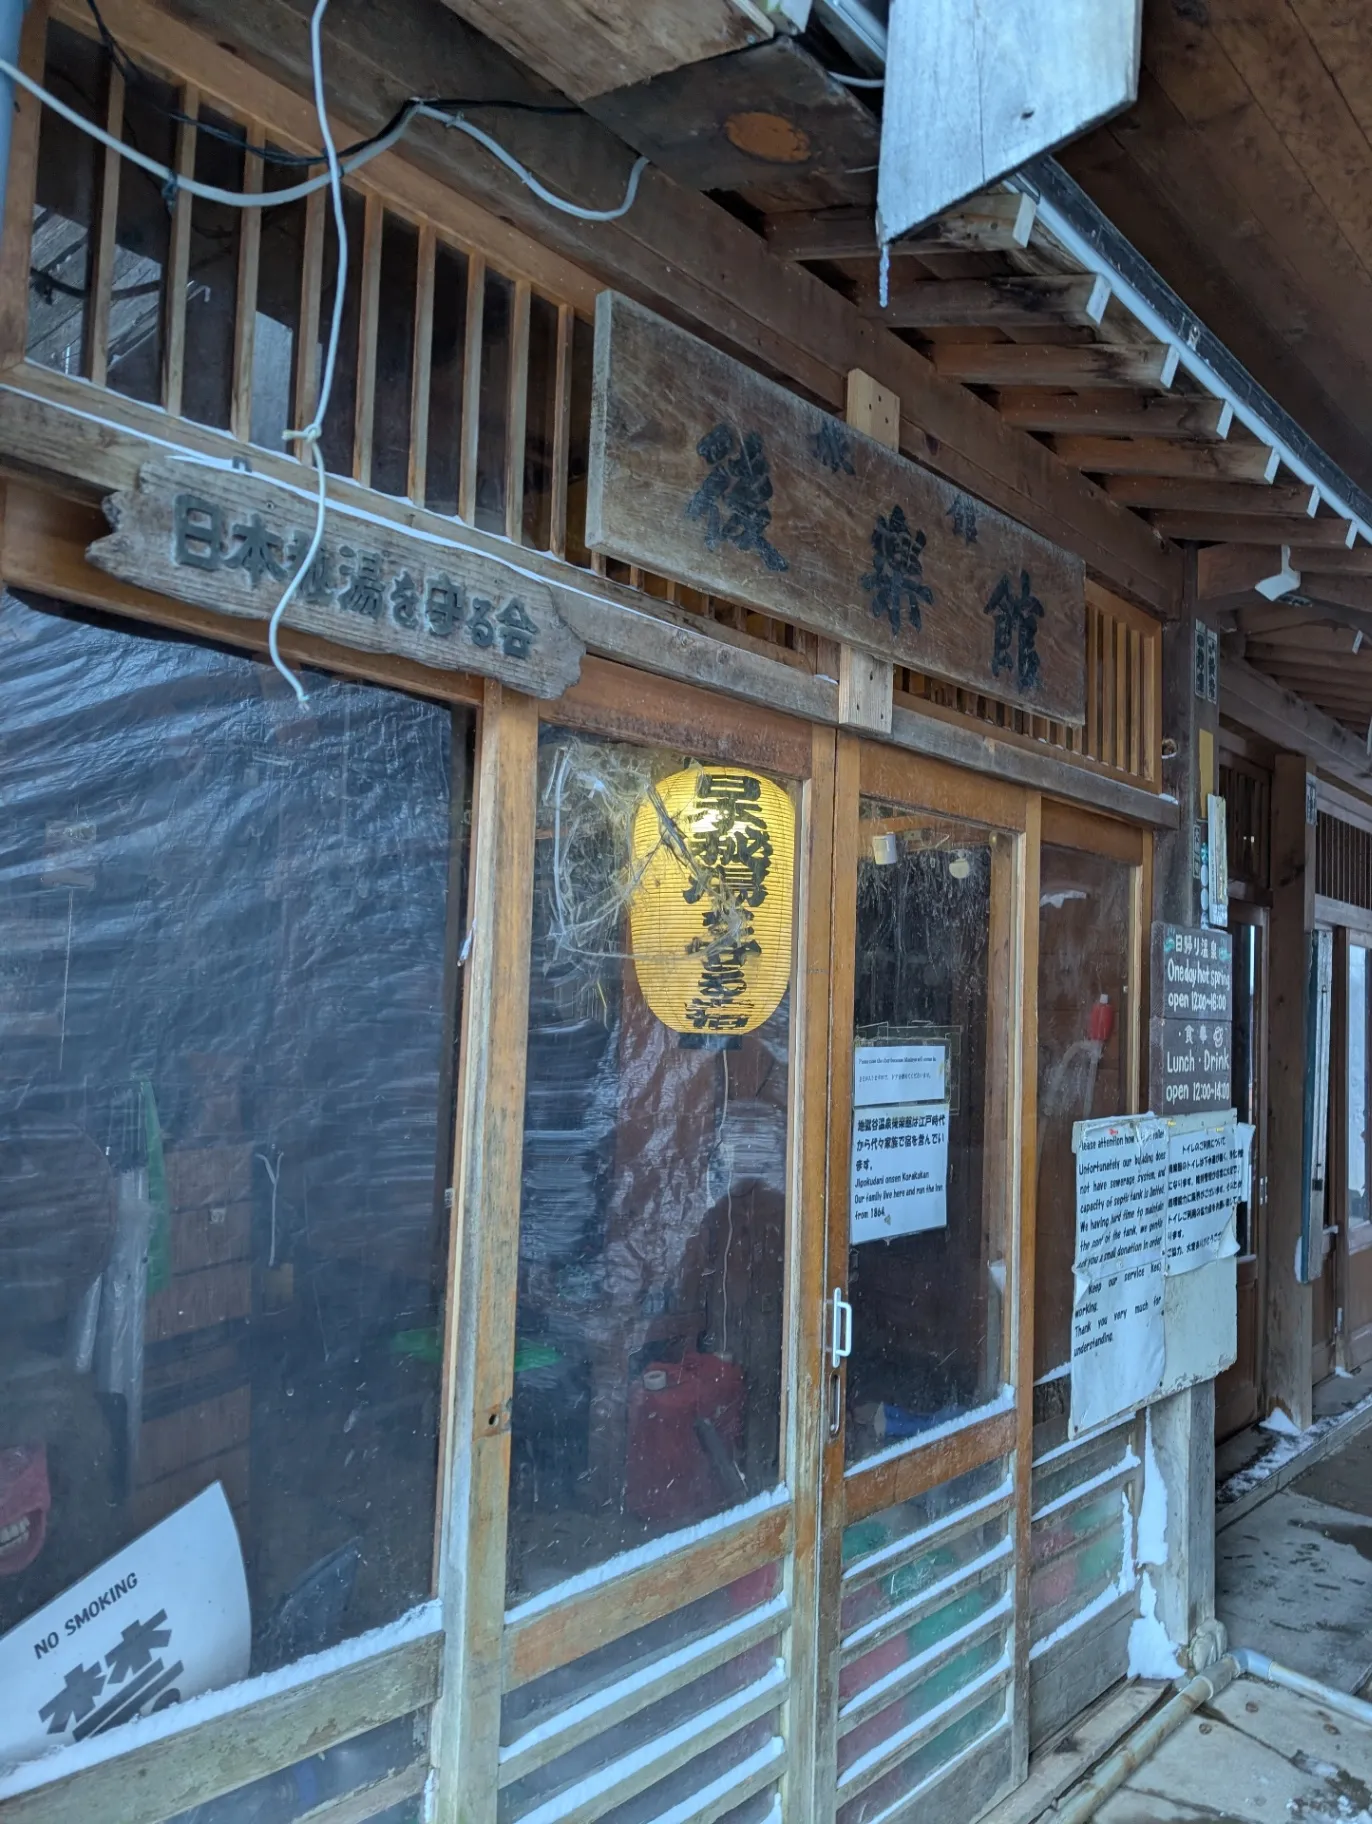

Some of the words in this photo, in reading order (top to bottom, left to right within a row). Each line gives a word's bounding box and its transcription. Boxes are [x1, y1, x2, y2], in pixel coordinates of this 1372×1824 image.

[1197, 960, 1210, 984] hot
[1210, 968, 1230, 991] spring
[1168, 991, 1189, 1012] open
[1167, 1051, 1195, 1073] Lunch
[1204, 1049, 1230, 1071] Drink
[1166, 1082, 1189, 1102] open
[1097, 1135, 1124, 1149] attention
[1124, 1135, 1134, 1146] how
[1079, 1159, 1120, 1176] Unfortunately
[1122, 1158, 1132, 1168] our
[1155, 1150, 1166, 1162] does
[885, 1174, 901, 1184] onsen
[1079, 1182, 1090, 1195] not
[1092, 1179, 1107, 1193] have
[1110, 1176, 1135, 1190] sewerage
[854, 1193, 865, 1204] Our
[865, 1191, 882, 1204] family
[883, 1189, 892, 1200] live
[893, 1188, 905, 1198] here
[906, 1186, 915, 1196] and
[916, 1186, 925, 1195] run
[926, 1184, 934, 1193] the
[1080, 1198, 1105, 1214] capacity
[1106, 1195, 1113, 1207] of
[1130, 1188, 1144, 1201] tank
[855, 1209, 869, 1220] from
[1080, 1221, 1089, 1233] We
[1090, 1217, 1109, 1231] having
[1136, 1206, 1144, 1217] to
[1079, 1239, 1090, 1252] the
[1116, 1241, 1142, 1257] donation
[1108, 1277, 1118, 1288] our
[1124, 1267, 1145, 1282] service
[1075, 1321, 1091, 1338] Thank
[1097, 1316, 1108, 1330] you
[1113, 1308, 1128, 1321] very
[1134, 1301, 1149, 1314] much
[1153, 1295, 1162, 1307] for
[33, 1631, 60, 1660] NO
[64, 1571, 139, 1637] SMOKING
